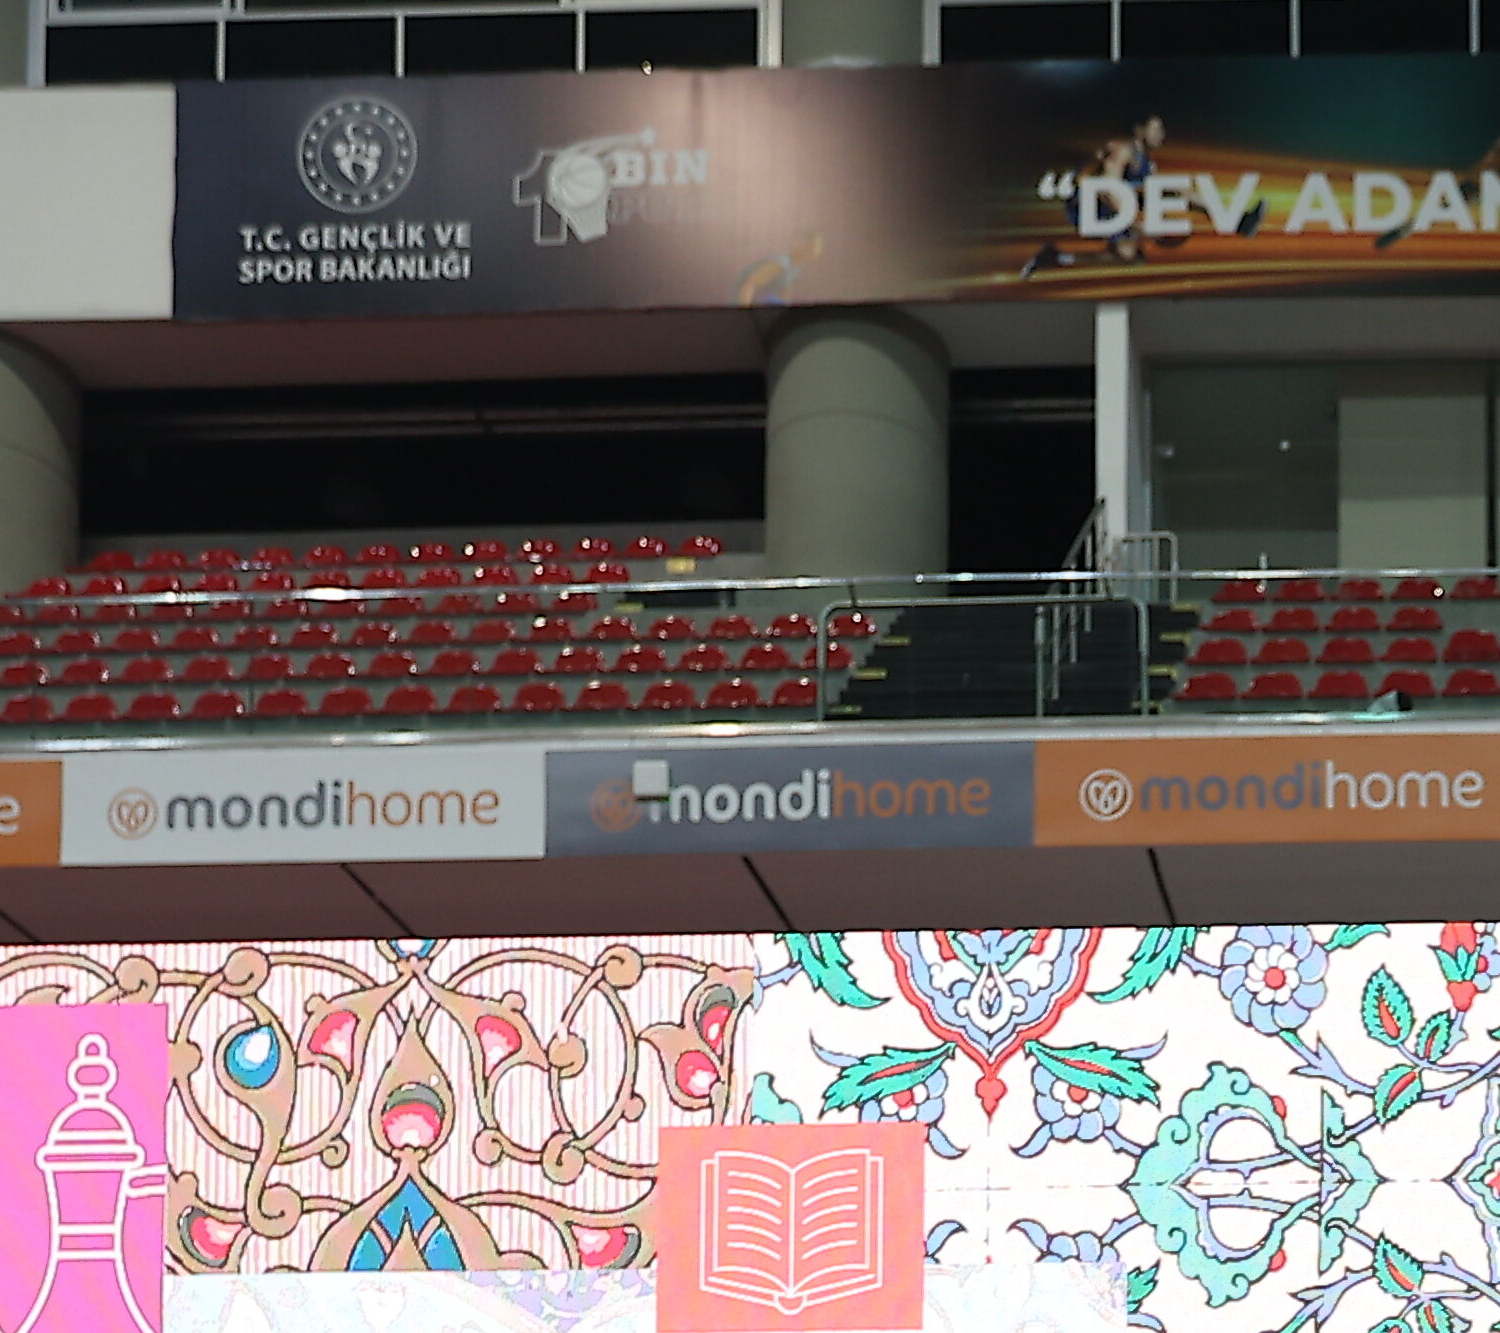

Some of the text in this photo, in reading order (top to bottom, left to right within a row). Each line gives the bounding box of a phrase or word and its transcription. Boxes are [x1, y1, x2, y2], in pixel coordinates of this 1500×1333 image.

[240, 217, 472, 252] T.C. GENÇLİK VE
[238, 249, 472, 284] SPOR BAKANLIĞI
[166, 779, 500, 832] mondihome
[648, 768, 991, 825] mondihome
[1139, 760, 1486, 813] mondihome
